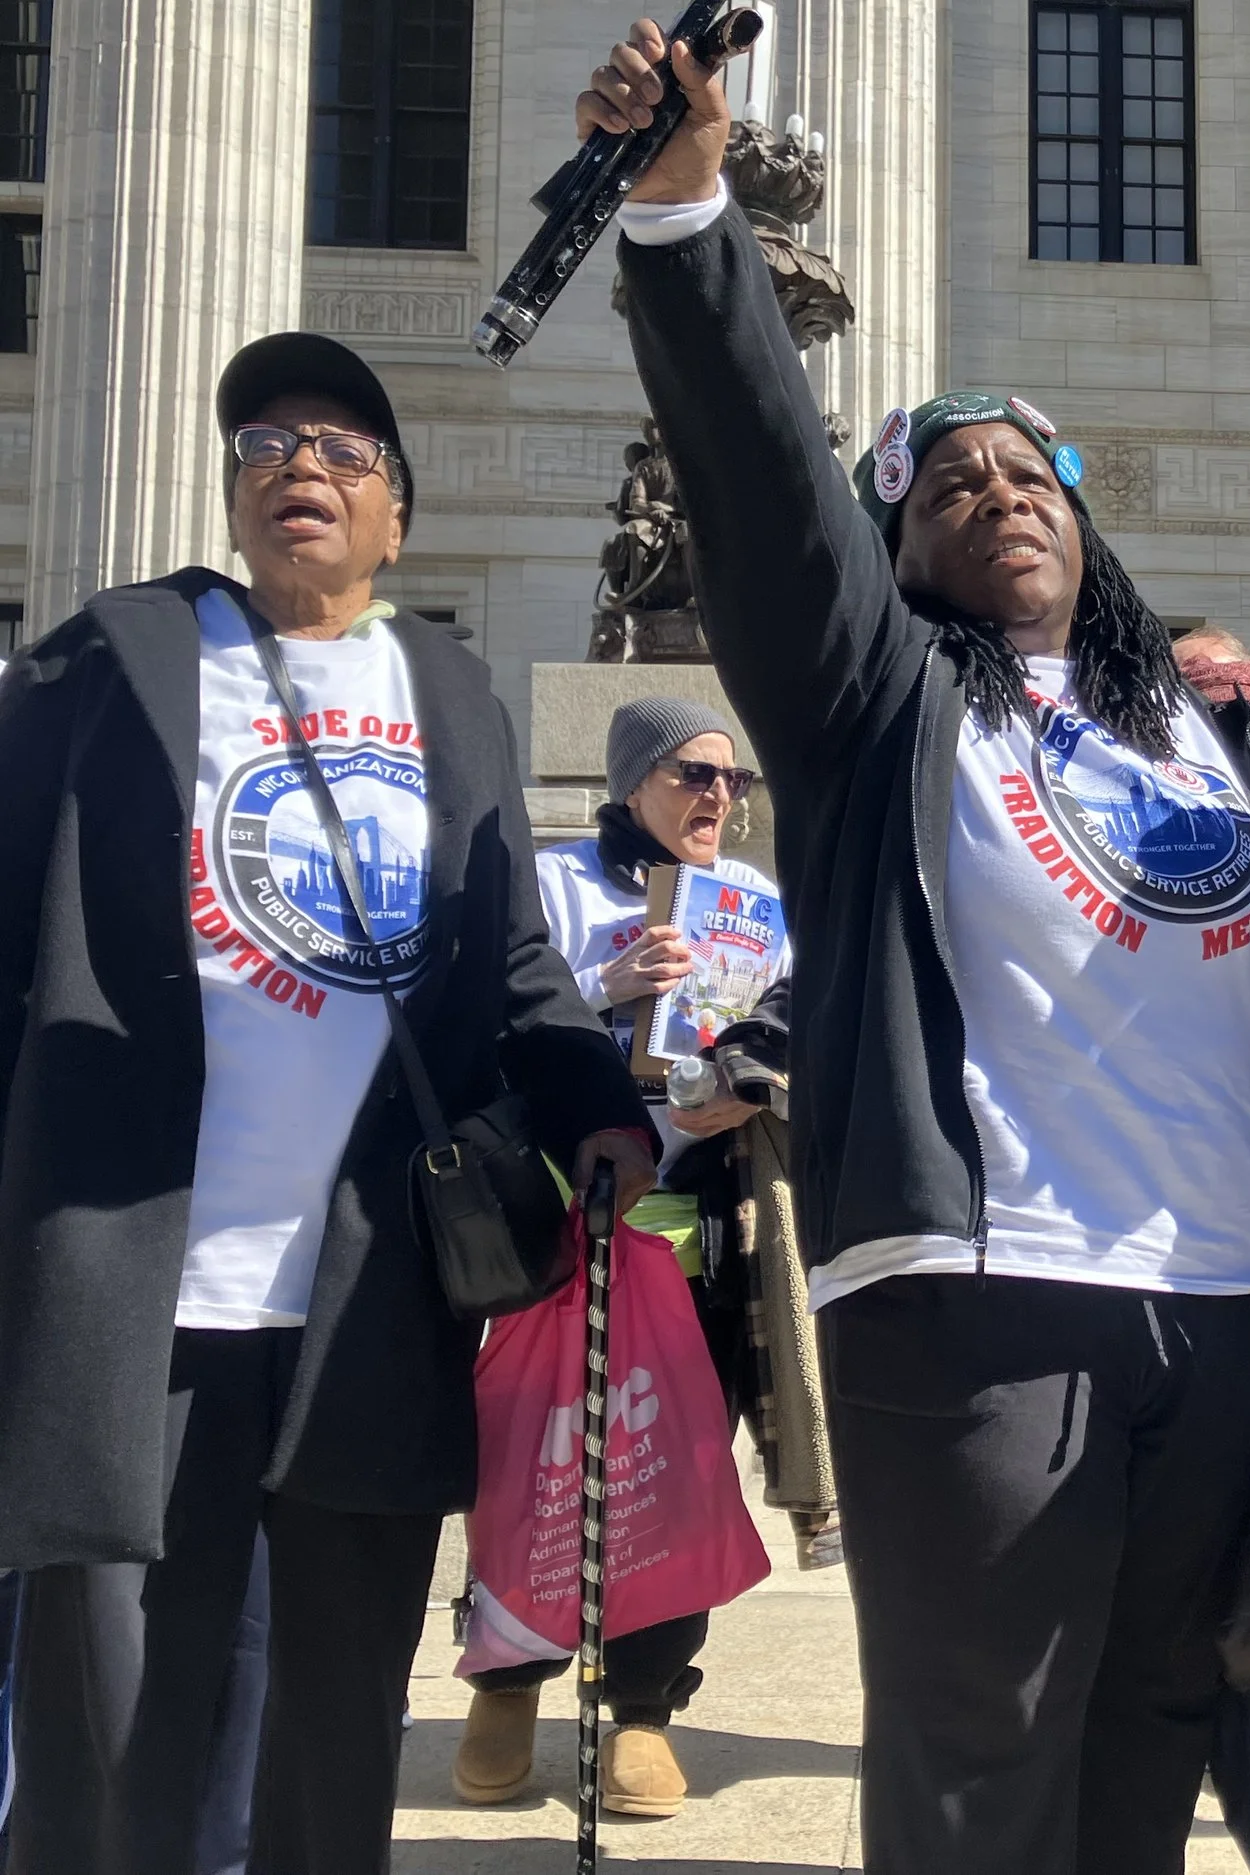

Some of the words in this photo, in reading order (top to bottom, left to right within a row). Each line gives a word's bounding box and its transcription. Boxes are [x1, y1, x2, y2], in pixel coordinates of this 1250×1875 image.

[945, 407, 1005, 421] ASSOCIATION
[359, 715, 425, 750] OU
[254, 774, 285, 799] NYC
[230, 829, 256, 842] EST.
[1127, 844, 1173, 853] STRONGER
[1174, 843, 1216, 852] TOGETHER
[1000, 768, 1148, 954] TRADITION
[1075, 811, 1133, 872] PUBLIC
[1133, 866, 1212, 897] SERVICE
[251, 876, 310, 939] PUBLIC
[366, 910, 407, 920] OGETHER
[717, 885, 773, 925] NYC
[702, 910, 776, 950] RETIREES
[634, 1433, 652, 1457] of
[604, 1455, 668, 1498] ervices
[532, 1518, 580, 1543] Human
[604, 1493, 658, 1520] sources
[620, 1544, 633, 1561] of
[532, 1579, 580, 1604] Homel
